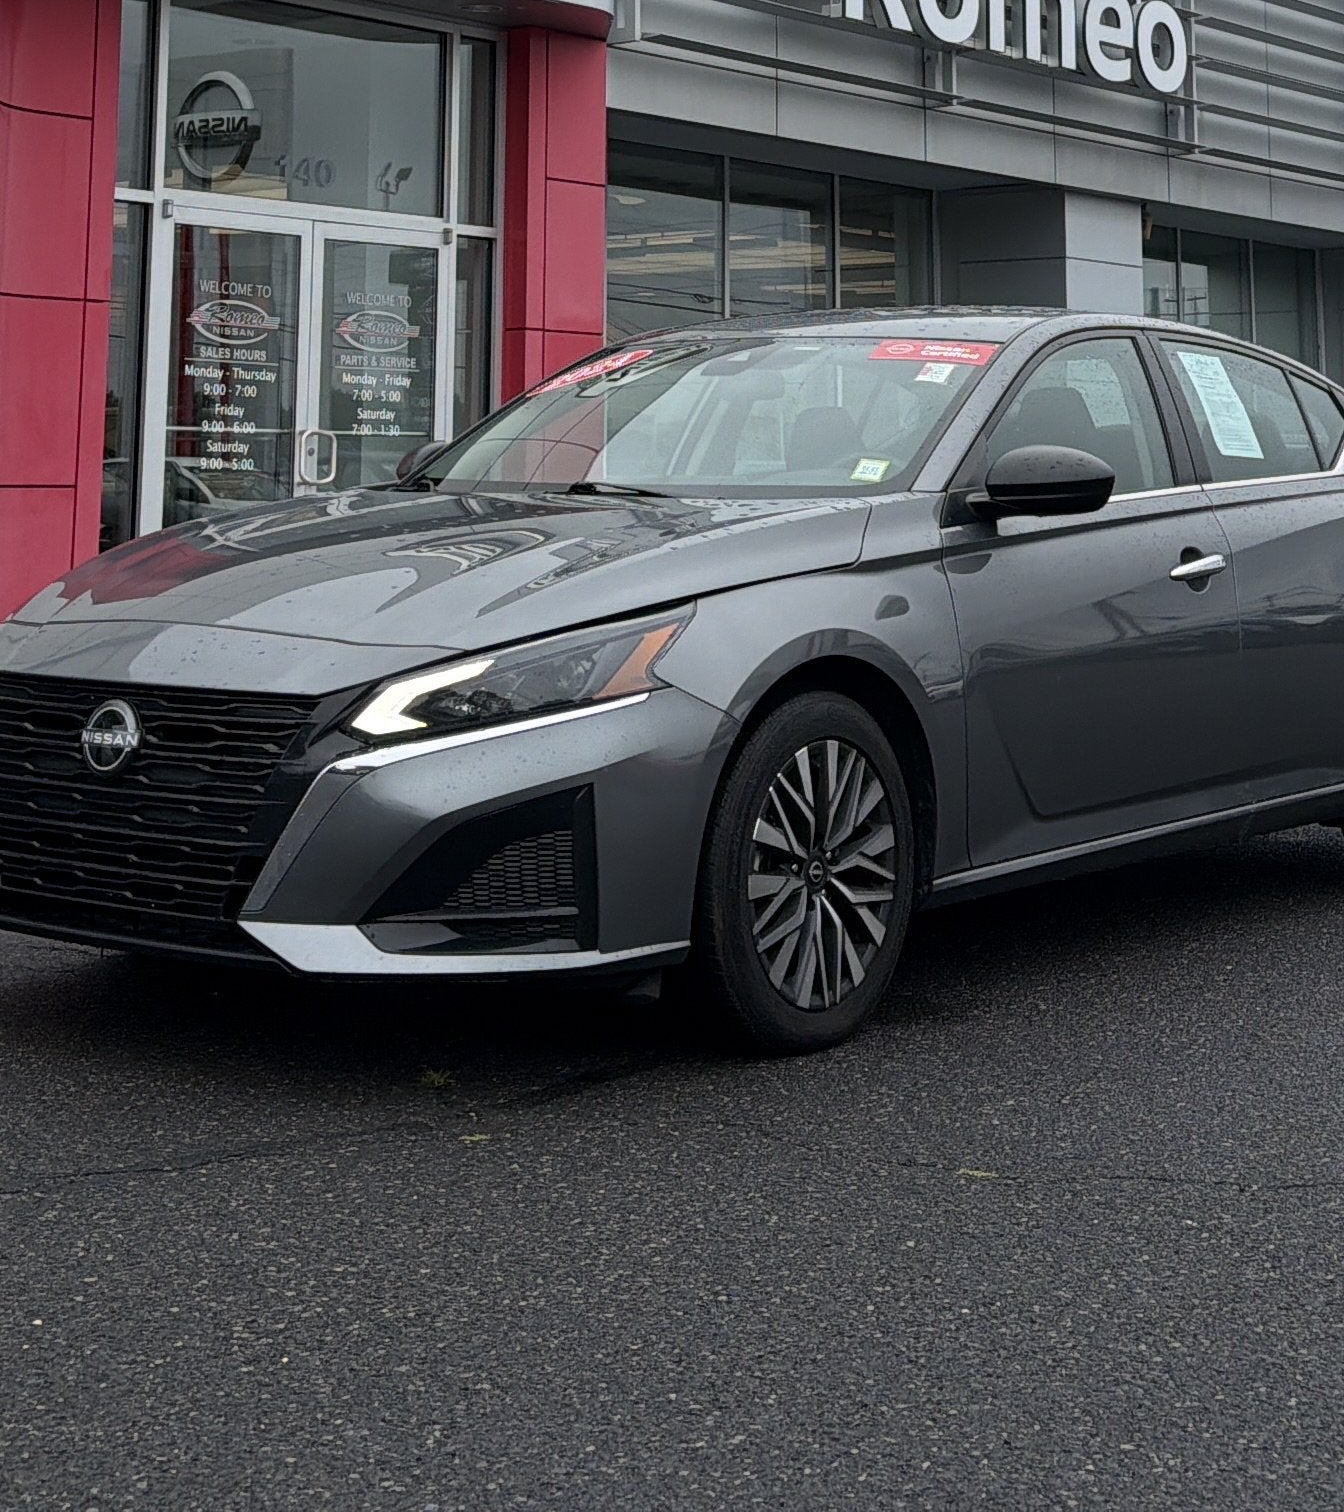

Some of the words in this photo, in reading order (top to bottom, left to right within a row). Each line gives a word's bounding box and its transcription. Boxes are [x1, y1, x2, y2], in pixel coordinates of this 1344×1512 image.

[199, 279, 254, 297] WELCOME
[255, 284, 272, 299] TO
[346, 291, 396, 307] WELCOME
[397, 295, 412, 308] TO
[204, 302, 266, 326] Romeo
[212, 327, 255, 337] NISSAN
[359, 335, 398, 345] NISSAN
[199, 346, 231, 359] SALES
[233, 348, 267, 362] HOURS
[340, 354, 369, 367] PARTS
[371, 356, 378, 367] &
[379, 356, 417, 369] SERVICE
[184, 364, 225, 381] Monday
[232, 367, 277, 384] Thursday
[342, 372, 377, 388] Monday
[384, 374, 412, 389] Friday
[203, 383, 226, 396] 9:00
[235, 385, 257, 398] 7:00
[352, 389, 373, 401] 7:00
[380, 390, 401, 402] 5:00
[214, 403, 245, 419] Friday
[357, 408, 396, 422] Saturday
[201, 420, 225, 433] 9:00
[233, 421, 256, 434] 6:00
[352, 424, 372, 436] 7:00
[380, 424, 400, 437] 1:30
[206, 440, 250, 455] Saturday
[200, 458, 223, 470] 9:00
[232, 458, 254, 471] 5:00
[81, 730, 139, 747] NISSAN
